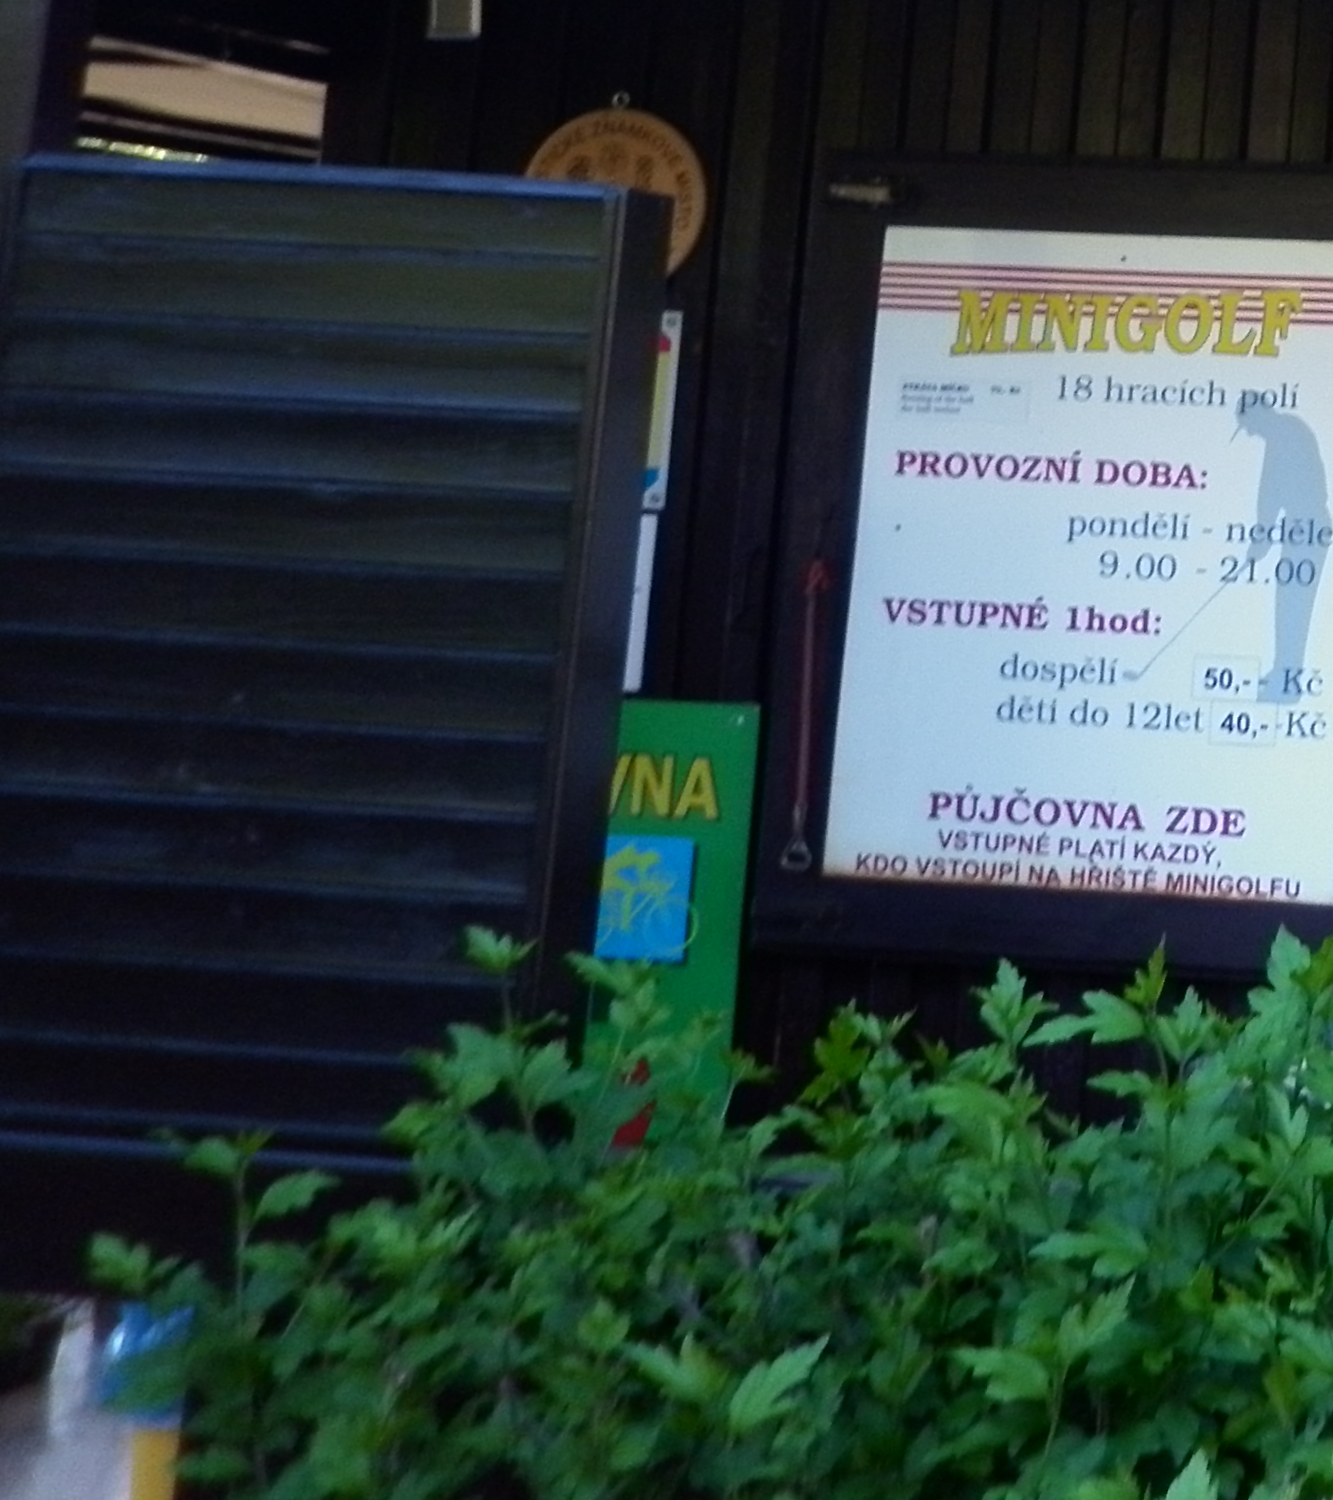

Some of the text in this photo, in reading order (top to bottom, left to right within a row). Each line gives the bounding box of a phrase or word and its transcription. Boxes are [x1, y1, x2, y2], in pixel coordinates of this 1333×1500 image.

[949, 288, 1303, 358] MINIGOLF
[1057, 373, 1300, 415] 18 hracích polí
[894, 449, 1209, 491] PROVOZNÍ DOBA:
[1066, 511, 1192, 544] pondělí
[1098, 549, 1178, 582] 9.00
[1218, 553, 1317, 588] 21.00
[883, 596, 1164, 637] VSTUPNÉ 1hod:
[999, 651, 1120, 693] dospělí
[1203, 666, 1252, 696] 50,-
[1282, 667, 1325, 698] Kč
[995, 694, 1328, 741] dětí do 12let 40,- Kč
[928, 784, 1247, 838] PŮJČOVNA ZDE
[938, 827, 1052, 857] VSTUPNÉ
[1058, 834, 1127, 863] PLATÍ
[854, 852, 909, 877] KDO
[915, 854, 1022, 883] VSTOUPÍ
[1027, 862, 1063, 887] NA
[1164, 871, 1302, 900] MINIGOLFU
